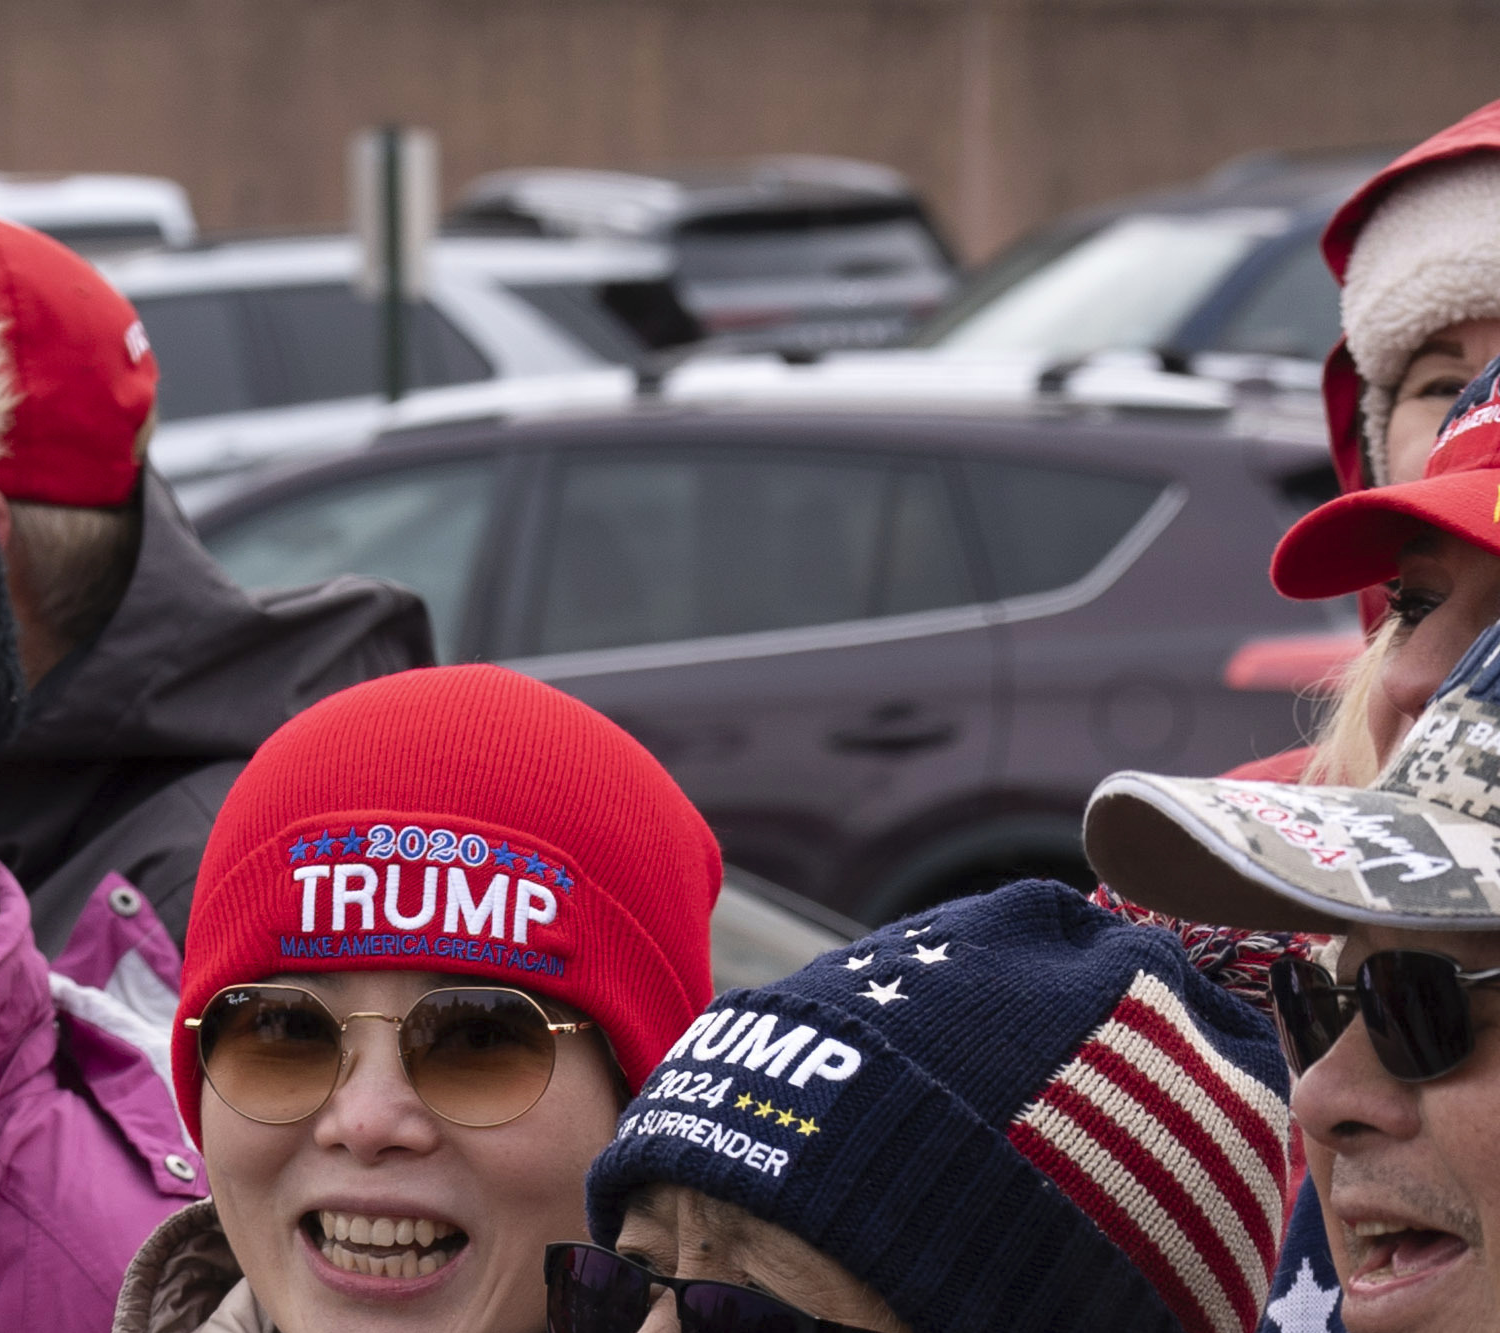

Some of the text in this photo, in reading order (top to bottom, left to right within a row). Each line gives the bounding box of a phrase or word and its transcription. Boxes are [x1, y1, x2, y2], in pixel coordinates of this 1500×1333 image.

[364, 823, 490, 868] 2020
[292, 862, 559, 946] TRUMP
[280, 933, 565, 978] MAKE AMERICA GREAT AGAIN
[662, 1007, 863, 1090] RUMP
[647, 1068, 735, 1109] 2024
[637, 1108, 790, 1178] SURRENDER
